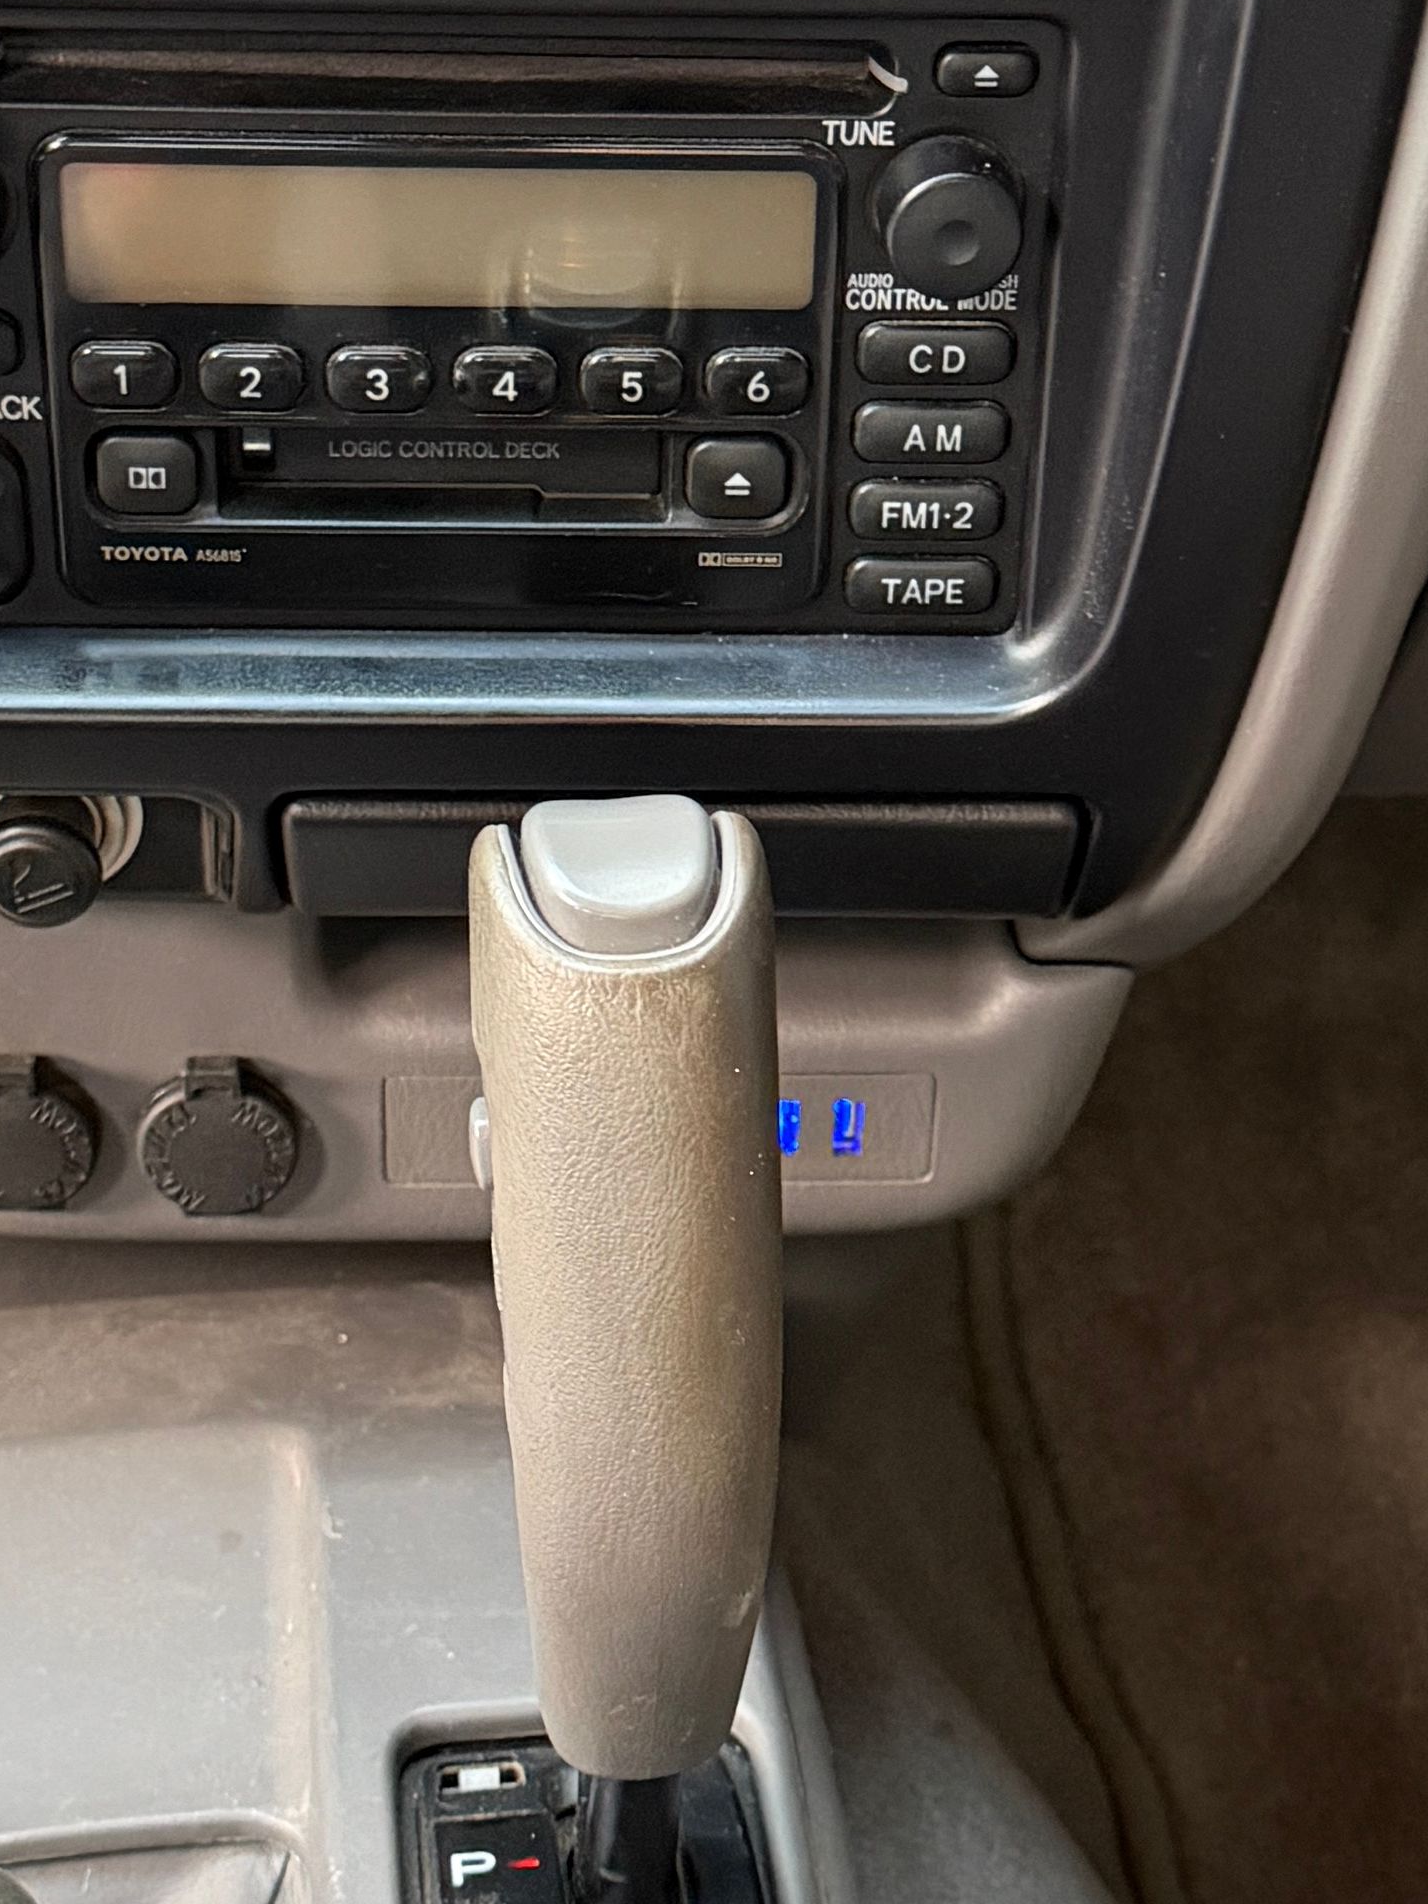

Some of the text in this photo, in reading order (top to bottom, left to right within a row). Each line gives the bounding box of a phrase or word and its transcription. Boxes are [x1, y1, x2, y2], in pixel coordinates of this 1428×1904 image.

[822, 121, 895, 146] TUNE
[847, 274, 894, 289] AUDIO
[908, 344, 966, 374] CD
[112, 364, 129, 395] 1
[239, 367, 262, 399] 2
[365, 368, 389, 400] 3
[492, 371, 518, 400] 4
[620, 371, 644, 402] 5
[746, 371, 771, 403] 6
[328, 441, 560, 459] LOGIC CONTROL DECK
[903, 424, 962, 452] AM
[100, 546, 188, 561] TOYOTA
[882, 578, 965, 604] TAPE
[450, 1851, 496, 1887] P
